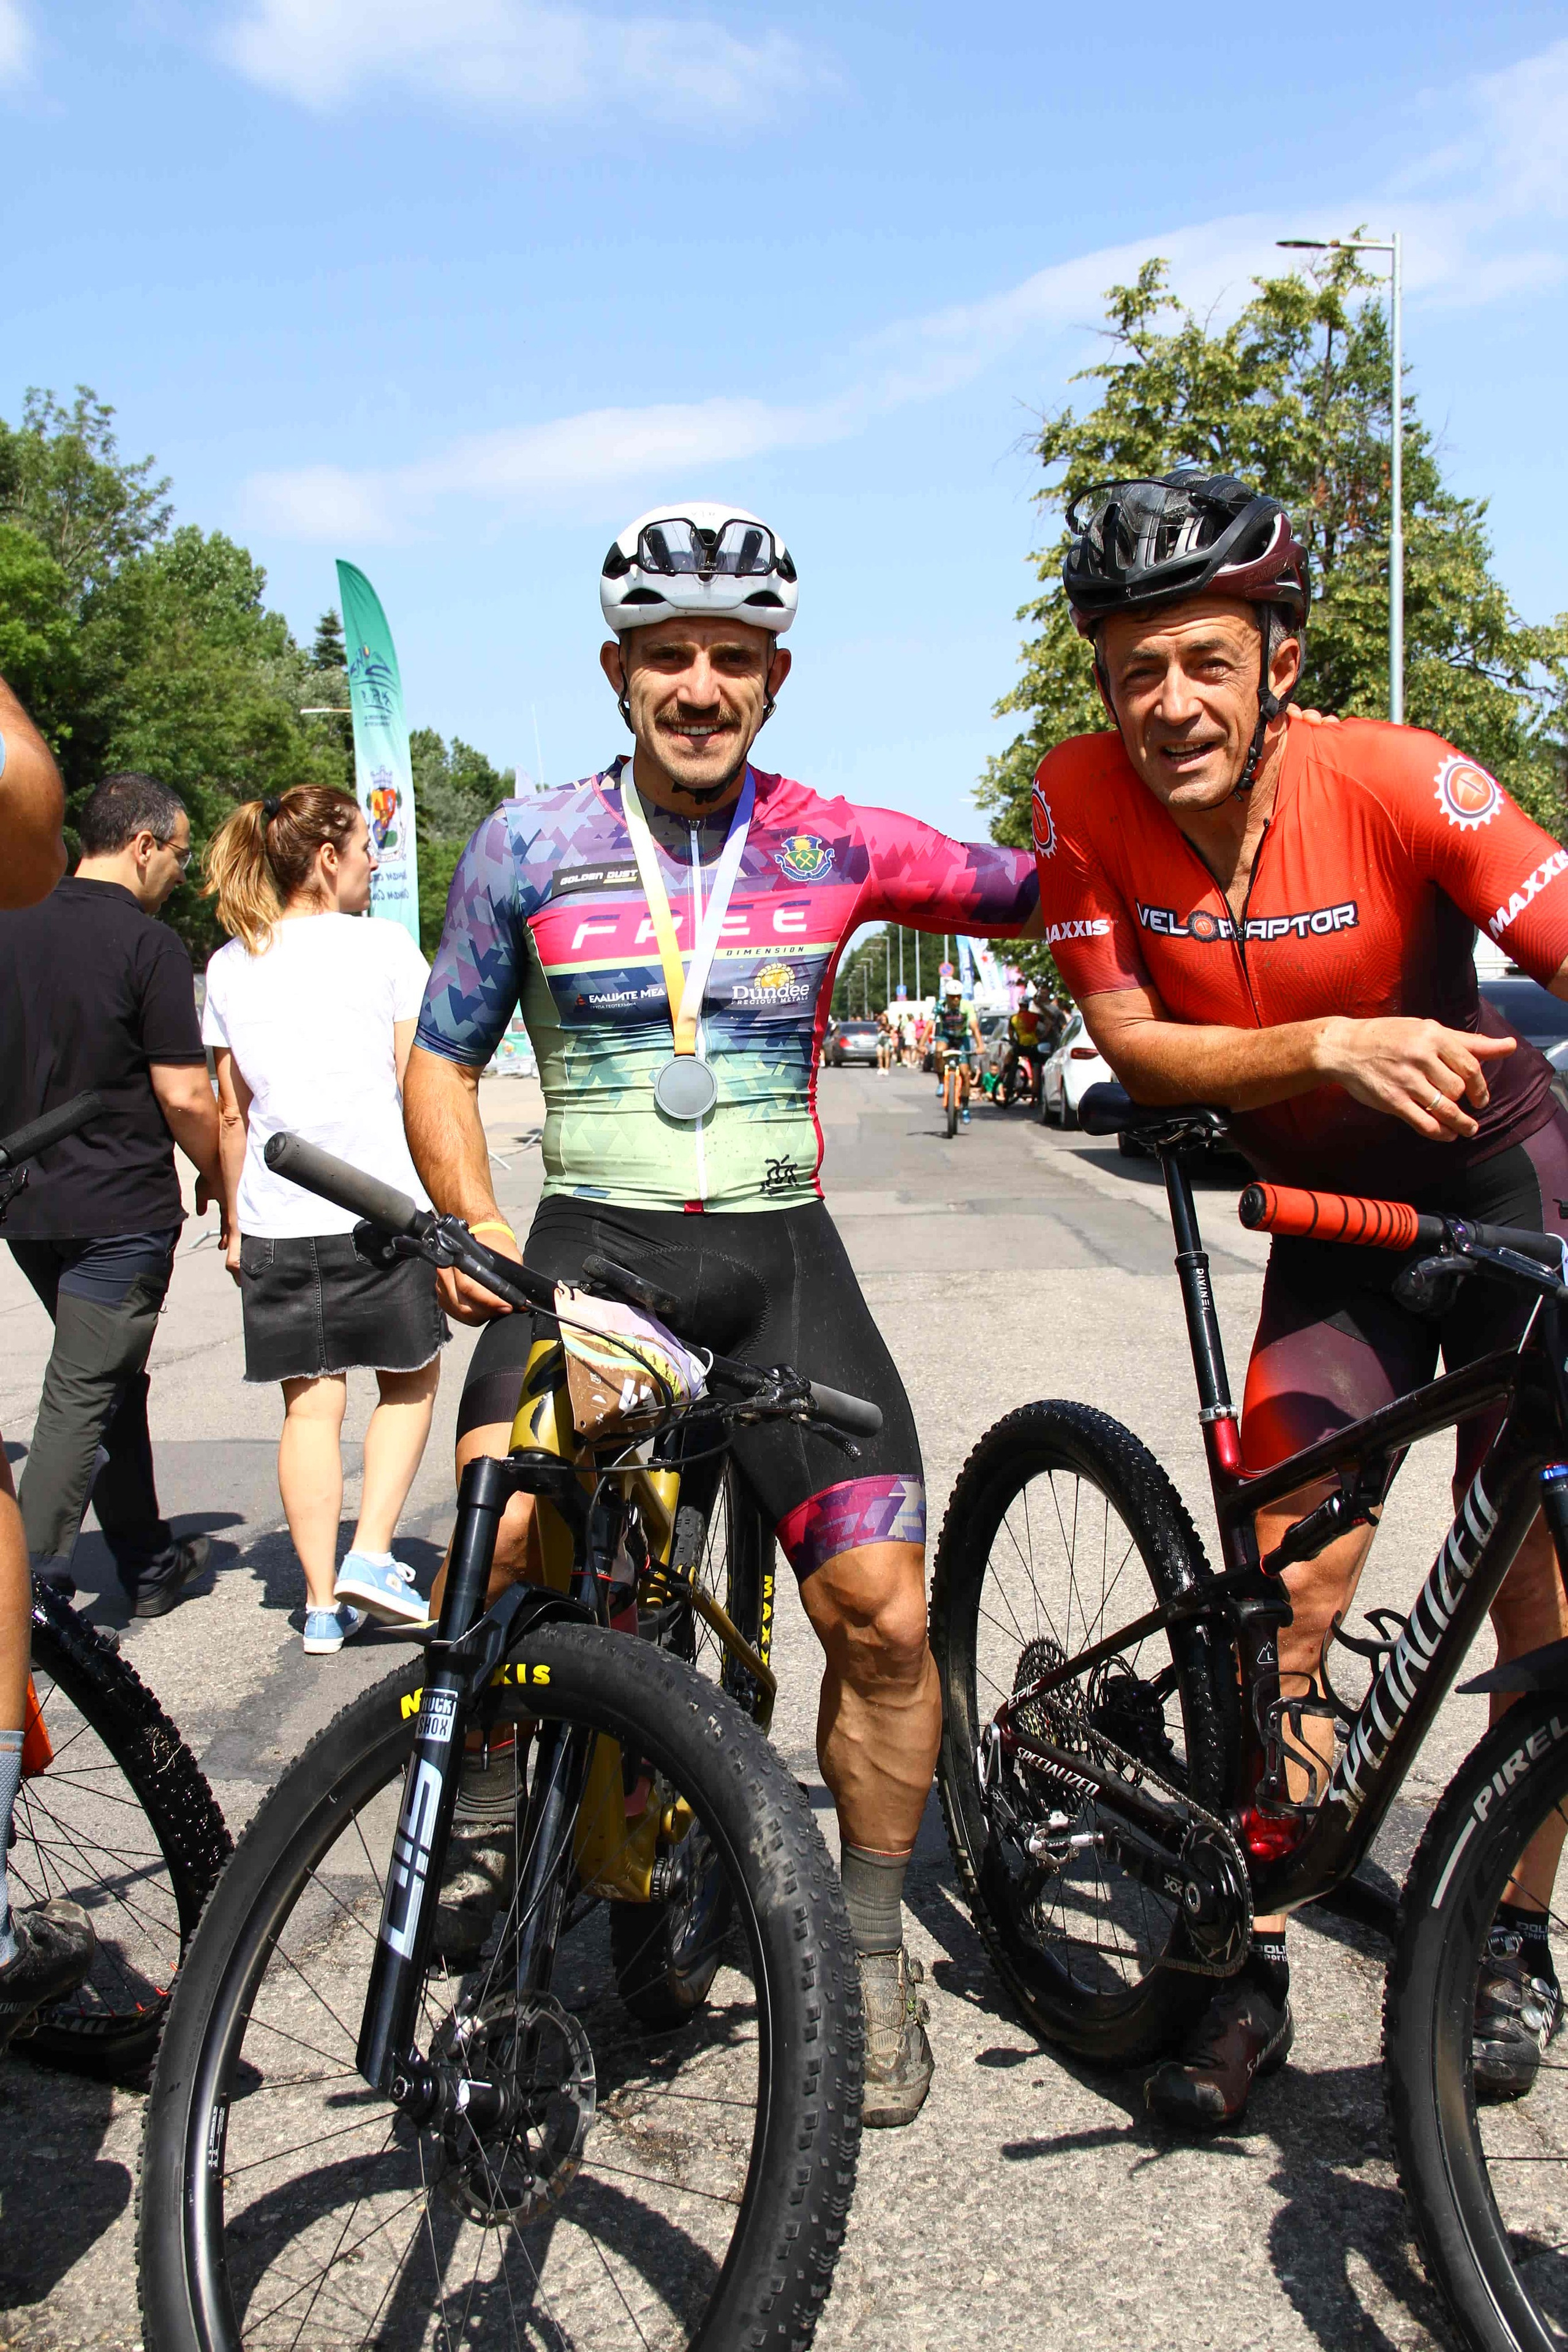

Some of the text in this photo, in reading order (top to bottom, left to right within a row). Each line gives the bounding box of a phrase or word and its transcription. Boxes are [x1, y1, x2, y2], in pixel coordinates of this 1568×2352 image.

[560, 869, 638, 886] GOLDEN DUST
[1046, 919, 1110, 944] AXXIS
[726, 946, 804, 956] DIMENSION
[640, 987, 666, 999] МЕД
[732, 983, 810, 1000] Dundee
[780, 995, 809, 1003] METALS
[1008, 1678, 1041, 1711] EPIC
[417, 1716, 448, 1736] SHOX
[1016, 1746, 1100, 1797] SPECIALIZED
